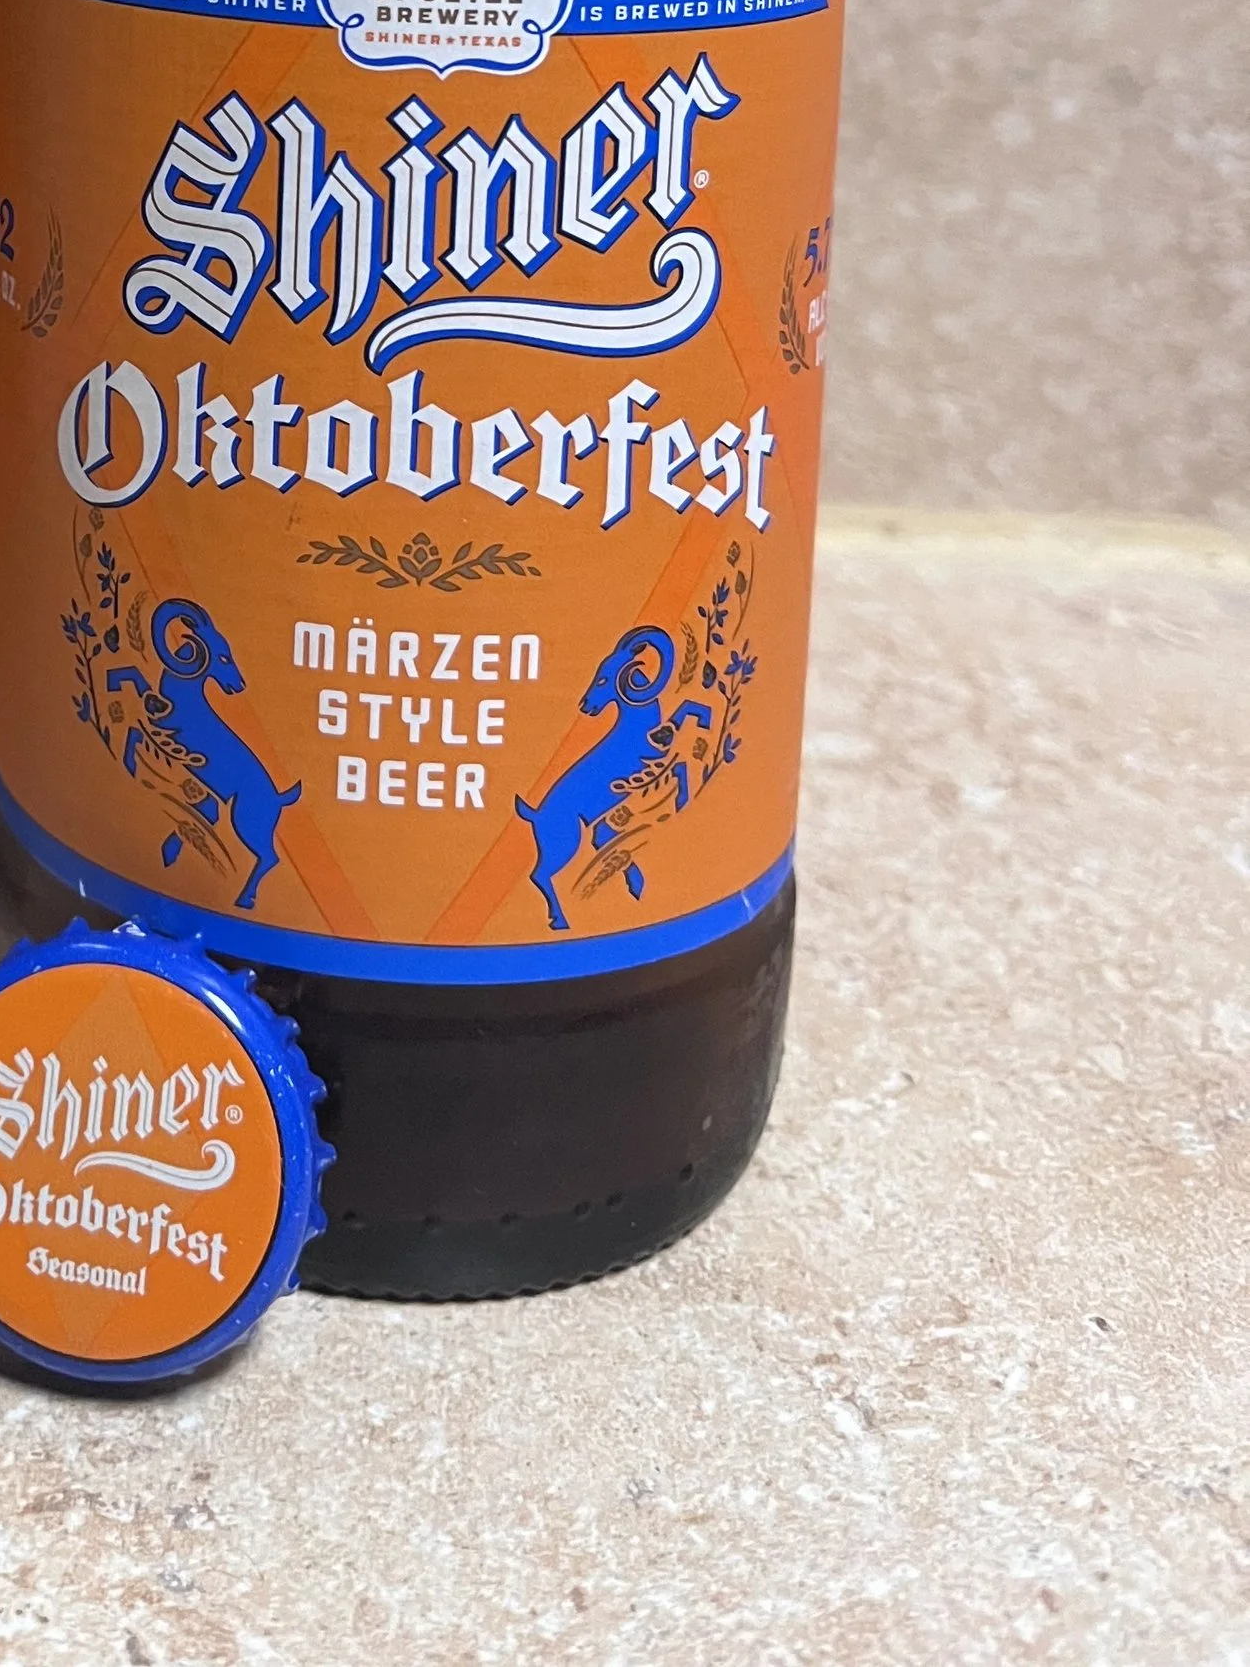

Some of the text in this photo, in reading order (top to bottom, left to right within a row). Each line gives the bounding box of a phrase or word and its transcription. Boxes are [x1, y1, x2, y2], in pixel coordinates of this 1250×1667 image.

[376, 5, 520, 27] BREWERY
[579, 5, 603, 22] IS
[614, 0, 709, 21] BREWED
[365, 30, 522, 48] SHINER TEXAS
[56, 359, 777, 533] Oktoberfest
[293, 616, 541, 681] MÄRZEN
[318, 688, 507, 746] STYLE
[336, 754, 486, 809] BEER
[26, 1246, 148, 1297] Seasonal
